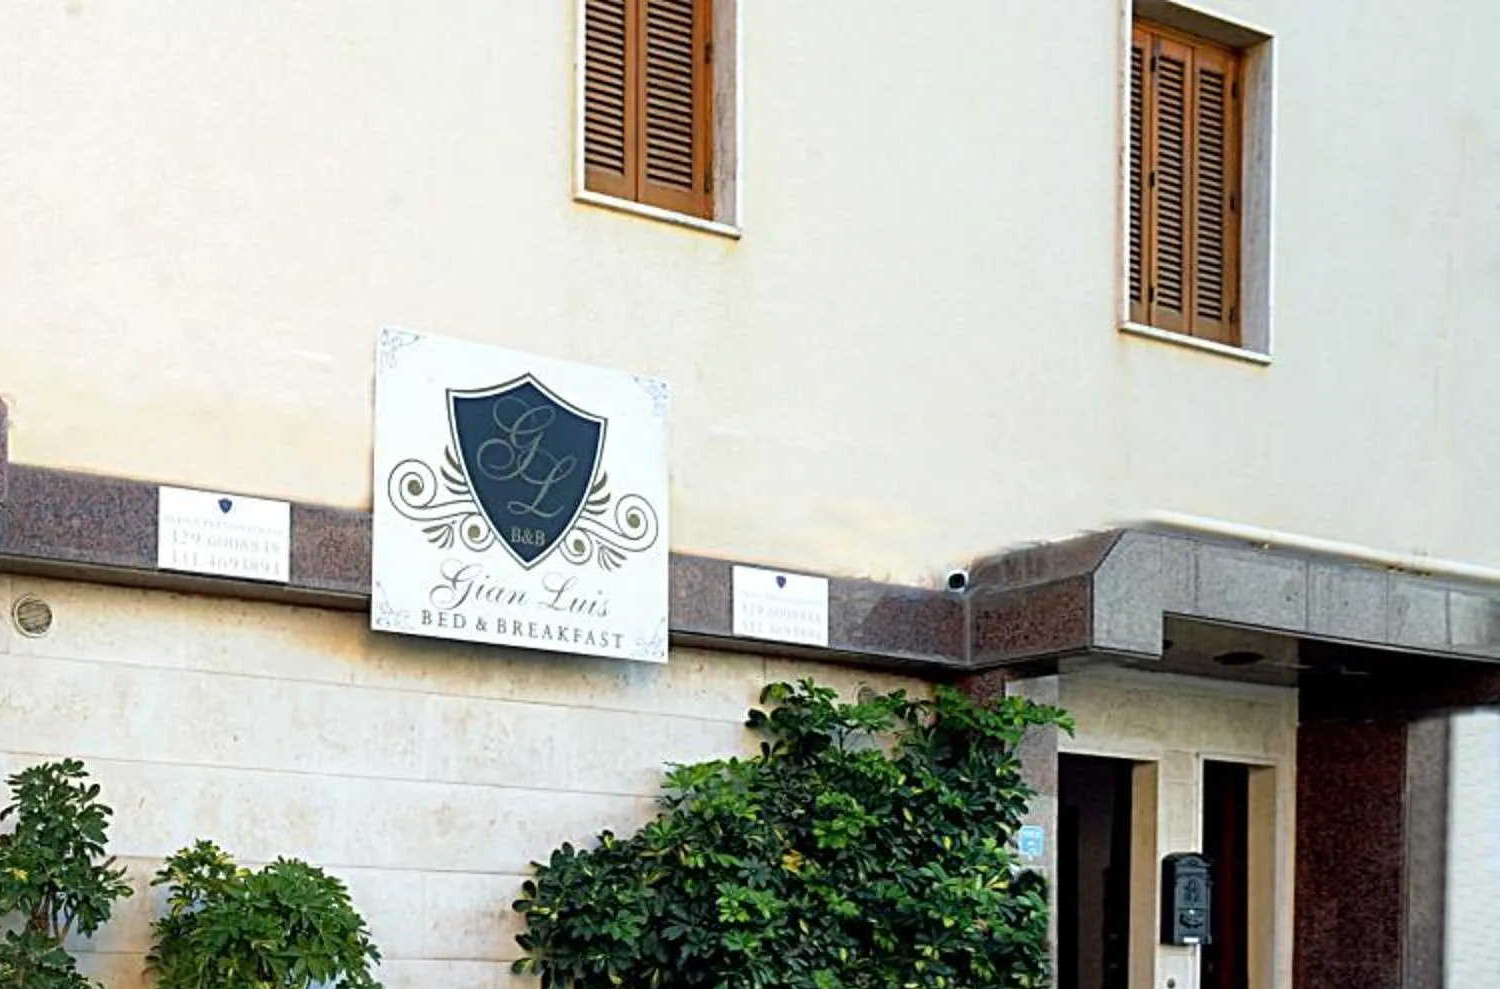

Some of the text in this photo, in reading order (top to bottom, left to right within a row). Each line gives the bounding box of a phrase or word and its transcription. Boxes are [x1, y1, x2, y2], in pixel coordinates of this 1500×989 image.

[511, 527, 545, 546] B&B
[430, 558, 610, 617] Gian Luis
[421, 609, 625, 649] BED & BREAKFAST
